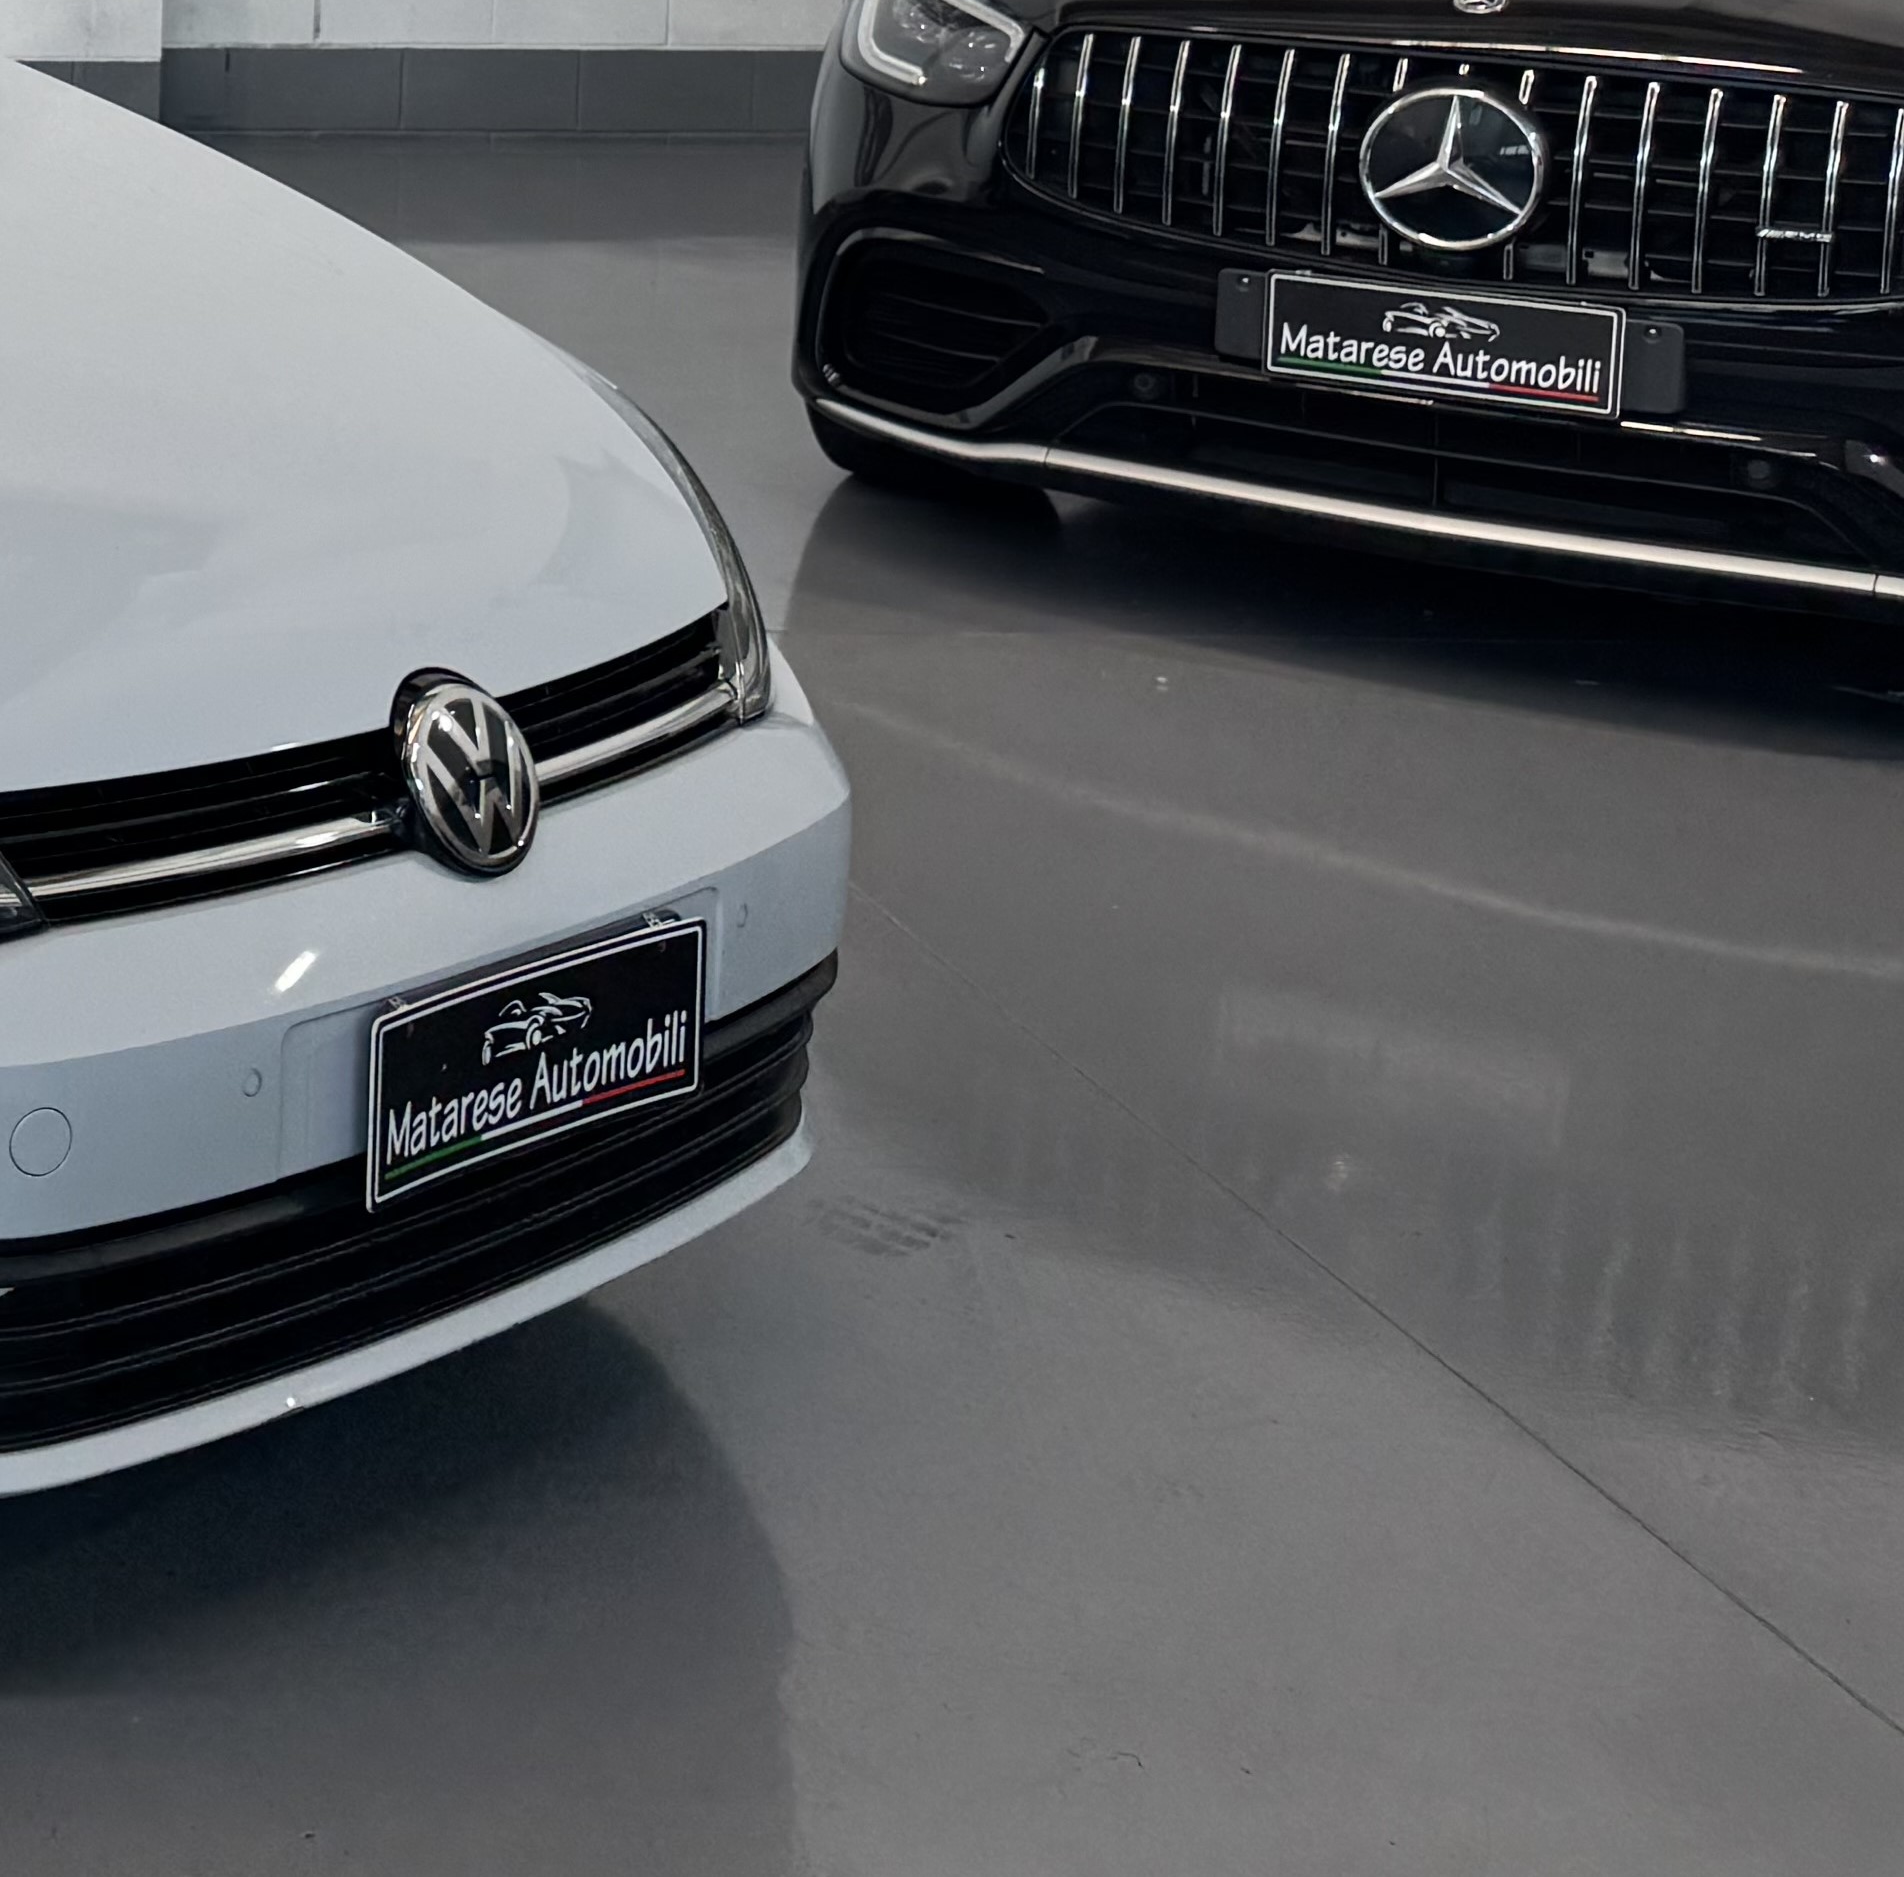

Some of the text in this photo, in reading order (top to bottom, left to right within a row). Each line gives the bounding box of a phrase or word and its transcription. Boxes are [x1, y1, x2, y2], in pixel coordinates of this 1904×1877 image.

[1279, 321, 1603, 395] Matarese Automobili
[385, 1009, 688, 1166] Matarese Automobili
